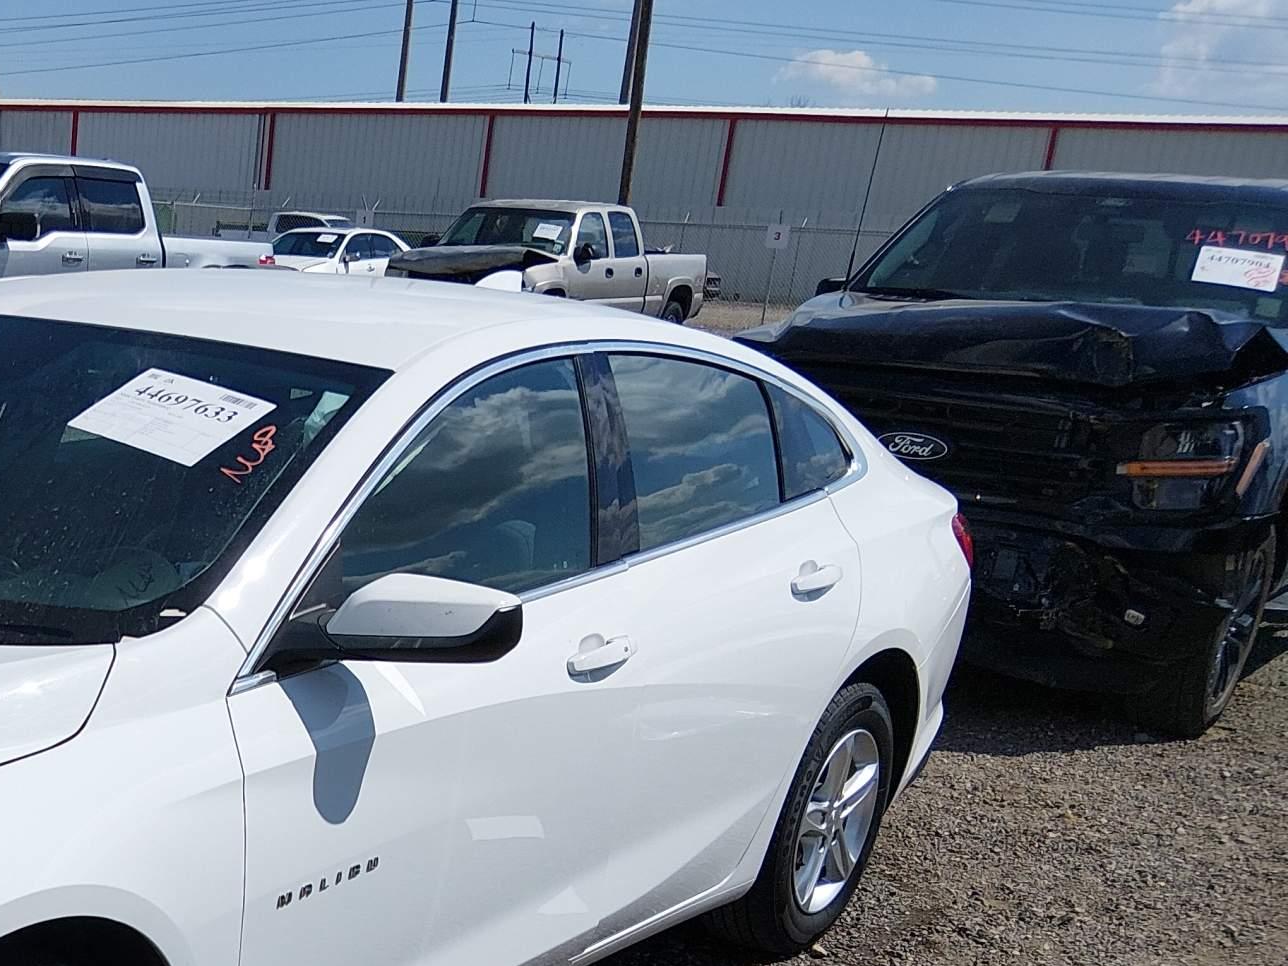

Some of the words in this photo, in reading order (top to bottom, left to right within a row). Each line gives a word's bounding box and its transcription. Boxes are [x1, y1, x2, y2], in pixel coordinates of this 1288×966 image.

[774, 231, 781, 241] 3
[135, 385, 239, 423] 44697633
[889, 435, 934, 456] Ford
